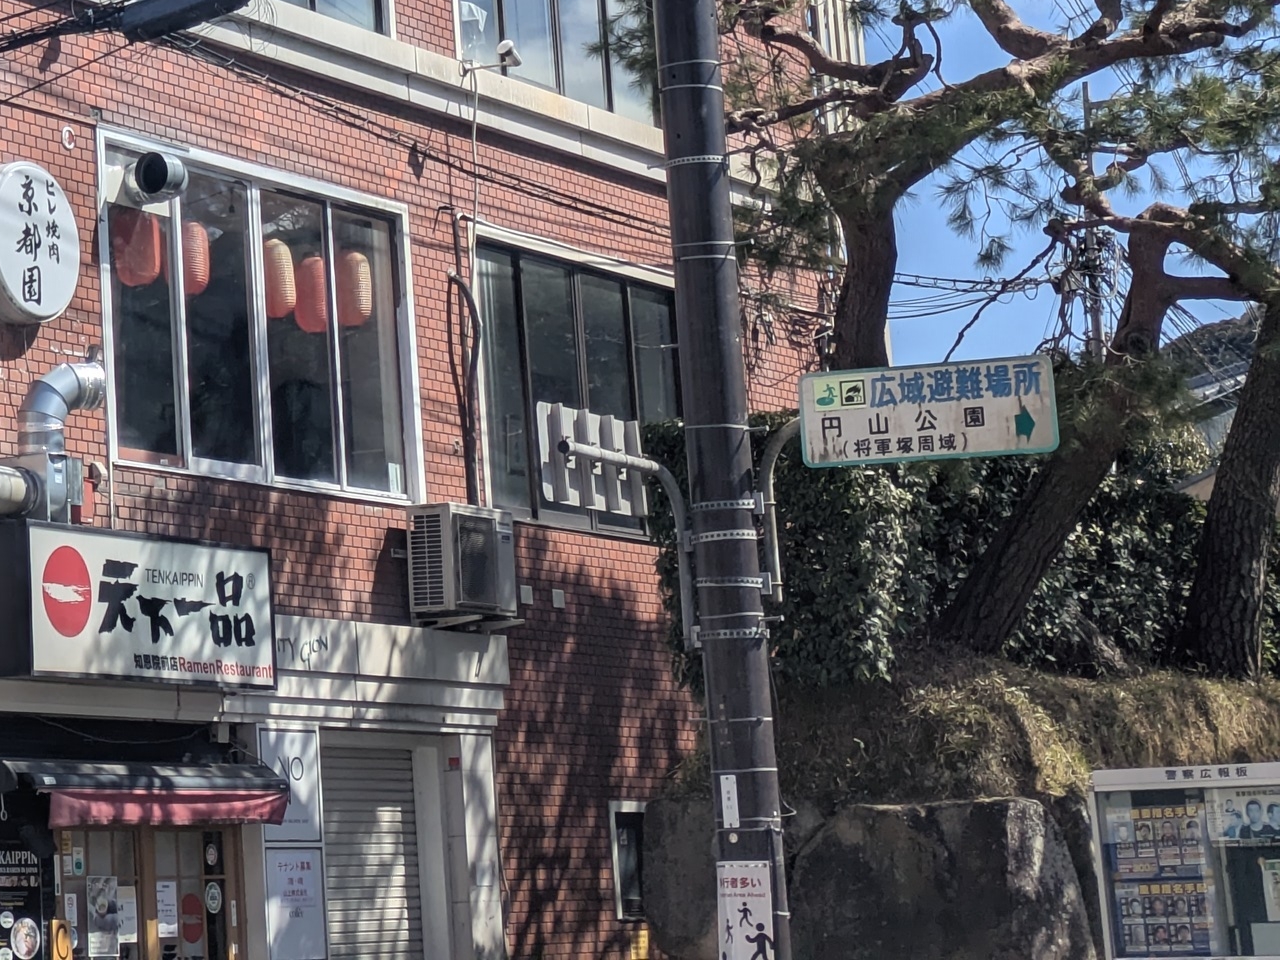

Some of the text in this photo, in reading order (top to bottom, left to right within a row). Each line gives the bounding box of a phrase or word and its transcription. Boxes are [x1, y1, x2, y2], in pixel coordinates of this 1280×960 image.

[15, 175, 42, 306] 京都園
[44, 179, 61, 265] ヒレ焼肉
[870, 361, 1041, 408] 広域避難場所
[821, 406, 985, 439] 円山公園
[145, 568, 204, 588] TENKAIPPIN
[98, 558, 256, 648] 天下一品
[1165, 766, 1248, 780] 警察広報板
